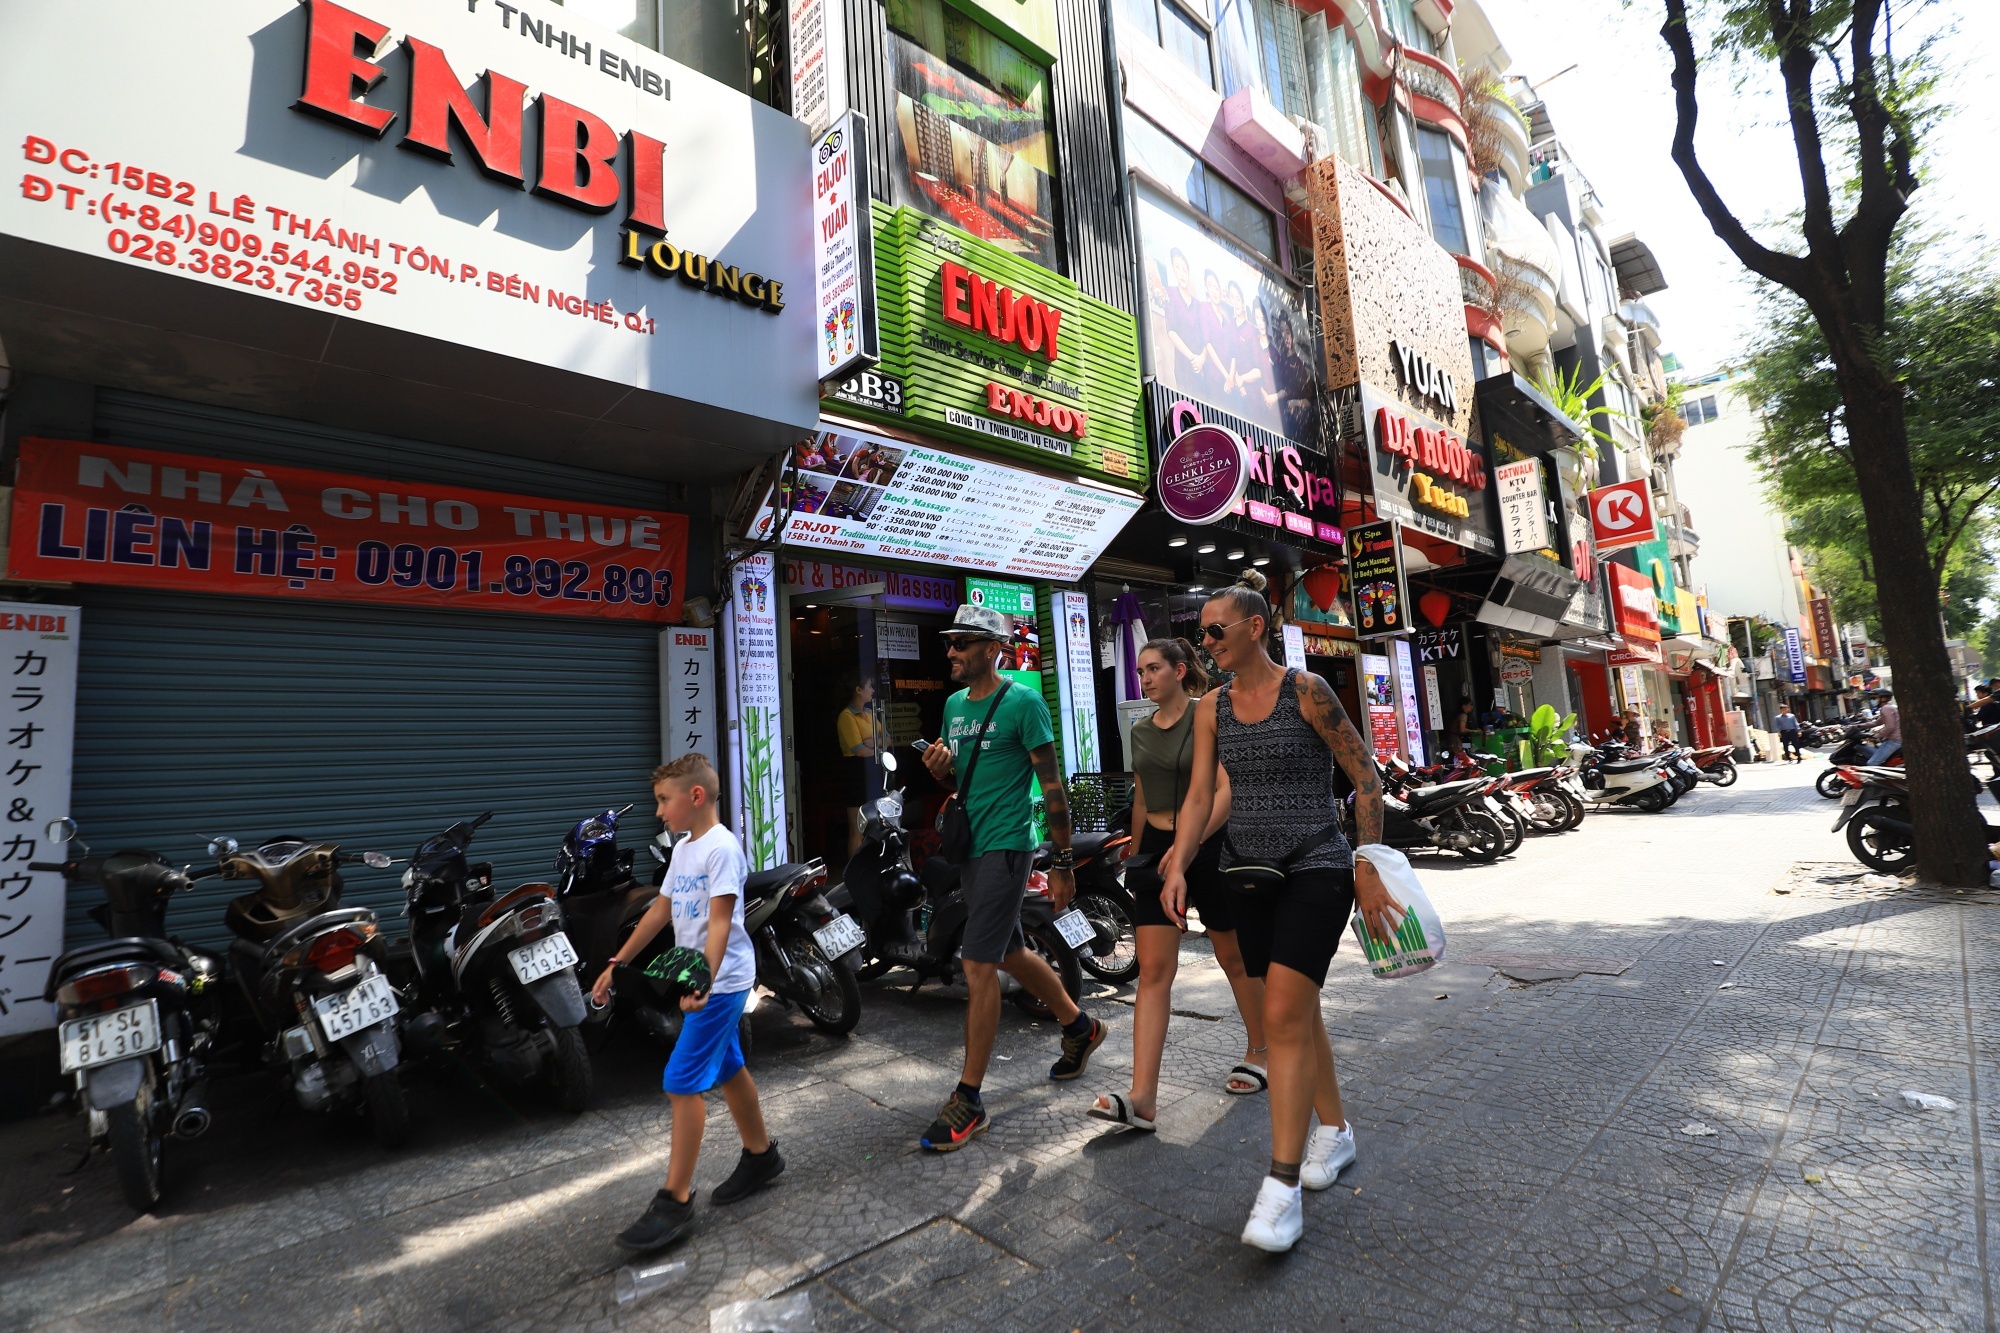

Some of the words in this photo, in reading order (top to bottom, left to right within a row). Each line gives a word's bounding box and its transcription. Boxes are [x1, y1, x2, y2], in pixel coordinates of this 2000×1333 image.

[499, 0, 592, 66] TNHH
[600, 53, 672, 102] ENBI
[289, 0, 668, 238] ENBI
[817, 149, 847, 199] ENJOY
[821, 200, 848, 243] YUAN
[22, 135, 196, 206] ĐC:15B2
[208, 191, 256, 223] LÊ
[266, 206, 381, 259] THÁNH
[388, 243, 456, 283] TÔN,
[460, 263, 481, 287] P.
[547, 289, 619, 329] NGHÉ,
[624, 312, 655, 335] Q.1
[917, 218, 963, 255] Spa
[107, 228, 363, 312] 028.3823.7355
[617, 230, 787, 316] LOUNGE
[941, 261, 1062, 362] ENJOY
[920, 328, 951, 355] Enjoy
[955, 340, 996, 369] Service
[998, 356, 1043, 389] Company
[1044, 373, 1080, 399] Limited
[1390, 339, 1459, 413] YUAN
[986, 381, 1090, 439] ENJOY
[949, 410, 973, 427] CÔNG
[974, 418, 986, 430] TY
[988, 422, 1010, 437] TNHH
[1011, 428, 1029, 442] DỊCH
[1030, 434, 1041, 447] VỤ
[1043, 437, 1068, 453] ENJOY
[1376, 407, 1419, 470] DẠ
[908, 449, 935, 461] Foot
[935, 454, 976, 472] Massage
[1165, 465, 1204, 485] GENKI
[1209, 457, 1231, 471] SPA
[1498, 462, 1534, 480] CATWALK
[914, 474, 946, 487] 260.000
[946, 481, 963, 491] VND
[921, 465, 953, 478] 180.000
[953, 471, 970, 482] VND
[1276, 446, 1336, 510] Spa
[1509, 477, 1526, 488] KTV
[78, 454, 290, 512] NHÀ
[321, 487, 479, 531] CHO
[503, 506, 661, 551] THUÊ
[882, 493, 910, 505] Body
[911, 498, 951, 513] Massage
[908, 484, 940, 496] 360.000
[940, 490, 957, 500] VND
[1064, 486, 1088, 499] Coconut
[1411, 472, 1470, 518] Yuan
[1502, 491, 1526, 504] COUNTER
[1526, 489, 1538, 498] BAR
[893, 507, 925, 519] 260.000
[925, 513, 943, 522] VND
[1092, 507, 1106, 515] VND
[1608, 495, 1641, 523] K
[791, 519, 841, 535] ENJOY
[840, 529, 879, 541] Traditional
[886, 535, 912, 547] Healthy
[911, 540, 937, 550] Massage
[883, 525, 914, 536] 450.000
[914, 530, 931, 538] VND
[888, 516, 920, 527] 350.000
[919, 521, 937, 530] VND
[1082, 519, 1096, 527] VND
[1364, 531, 1382, 539] Spa
[1509, 503, 1524, 550] カラオケ
[786, 531, 809, 541] 15B3
[809, 534, 820, 543] Le
[822, 536, 849, 547] Thanh
[849, 540, 865, 549] Ton
[878, 544, 894, 553] TEL:
[895, 547, 949, 561] 028.2210.4990
[1364, 539, 1394, 552] Yuan
[37, 502, 212, 571] LIÊN
[234, 523, 337, 589] HỆ:
[355, 540, 673, 607] 0901.892.893
[1370, 557, 1390, 566] Massage
[812, 562, 825, 588] &
[1374, 566, 1395, 574] Massage
[1067, 596, 1085, 604] ENJOY
[0, 612, 66, 633] ENBI
[764, 628, 773, 636] VND
[675, 633, 707, 647] ENBI
[765, 639, 773, 647] VND
[1418, 628, 1459, 645] カラオケ
[765, 650, 774, 658] VND
[1420, 643, 1459, 662] KTV
[684, 657, 703, 750] カラオケ
[820, 919, 849, 944] 71-B1
[1059, 914, 1083, 933] 59-C2
[518, 938, 559, 963] 67-C1
[825, 929, 861, 957] 624.46
[520, 949, 573, 980] 219.45
[77, 1011, 142, 1042] 51-S4
[329, 997, 392, 1035] 457.63
[79, 1030, 144, 1063] 8430
